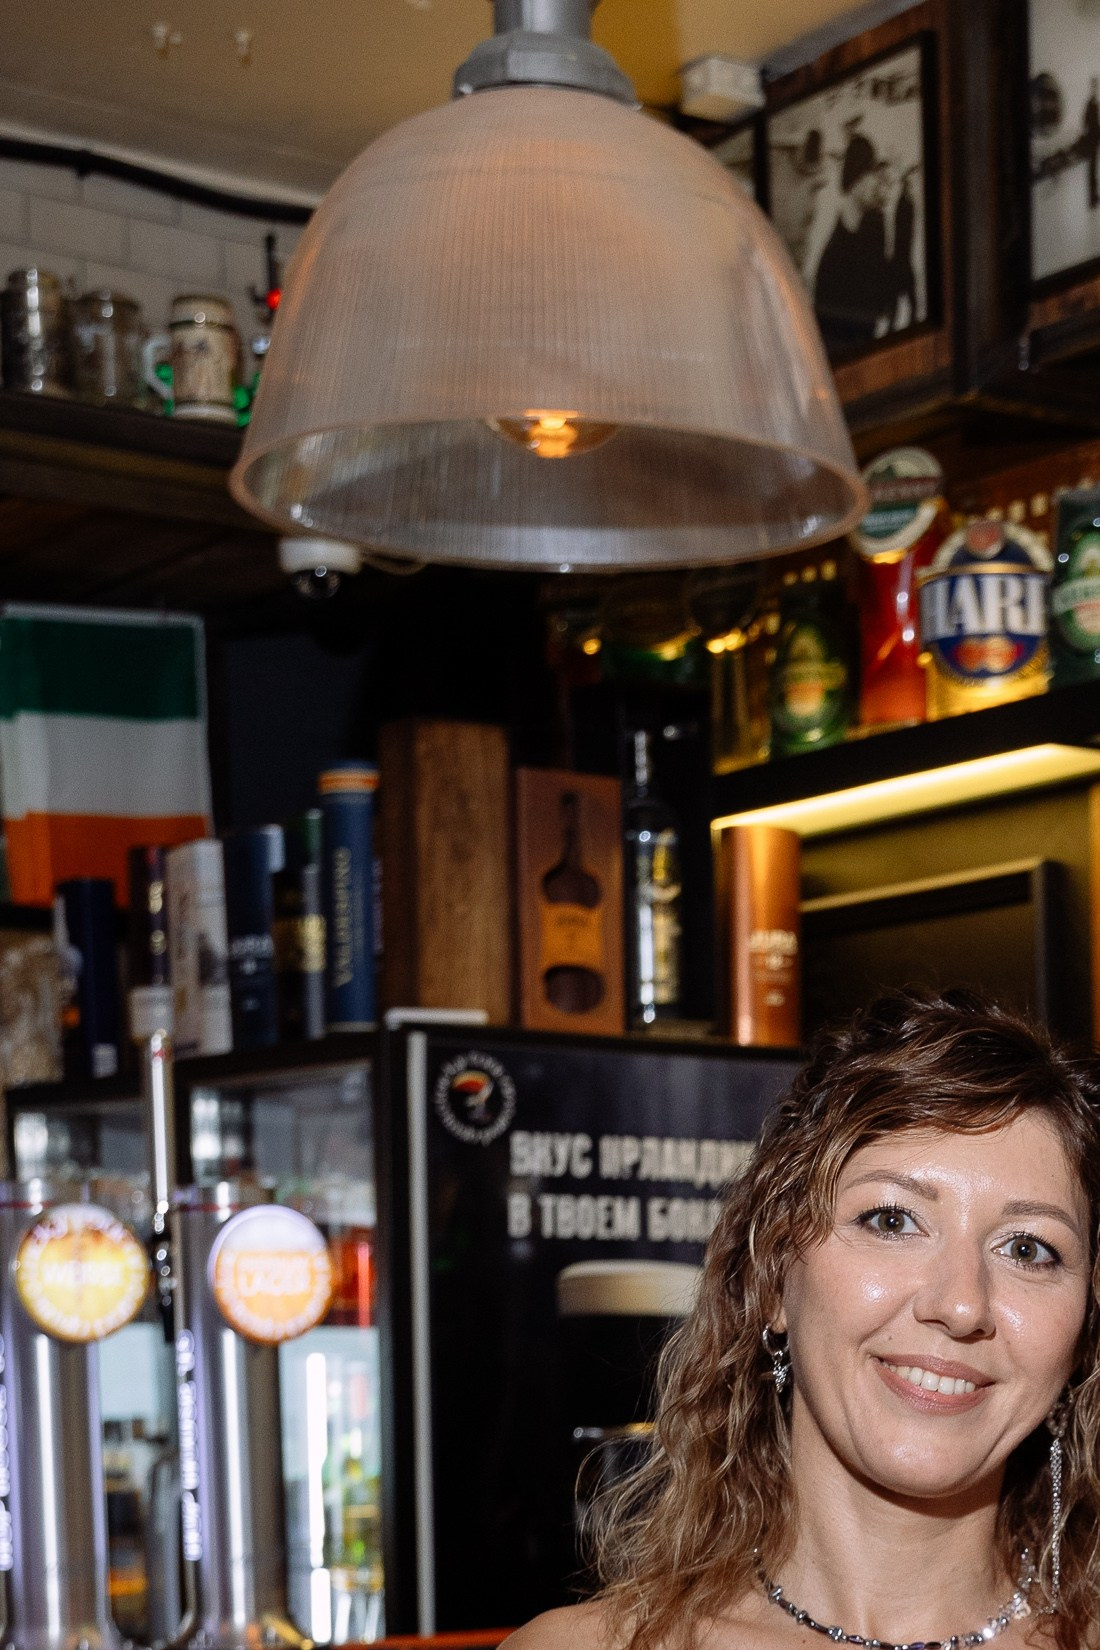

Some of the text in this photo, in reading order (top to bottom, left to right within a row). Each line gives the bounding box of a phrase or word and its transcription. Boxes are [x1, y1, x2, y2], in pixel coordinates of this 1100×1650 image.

[510, 1130, 593, 1179] ВКУС
[507, 1193, 532, 1238] В
[537, 1193, 641, 1240] ТВОЕМ
